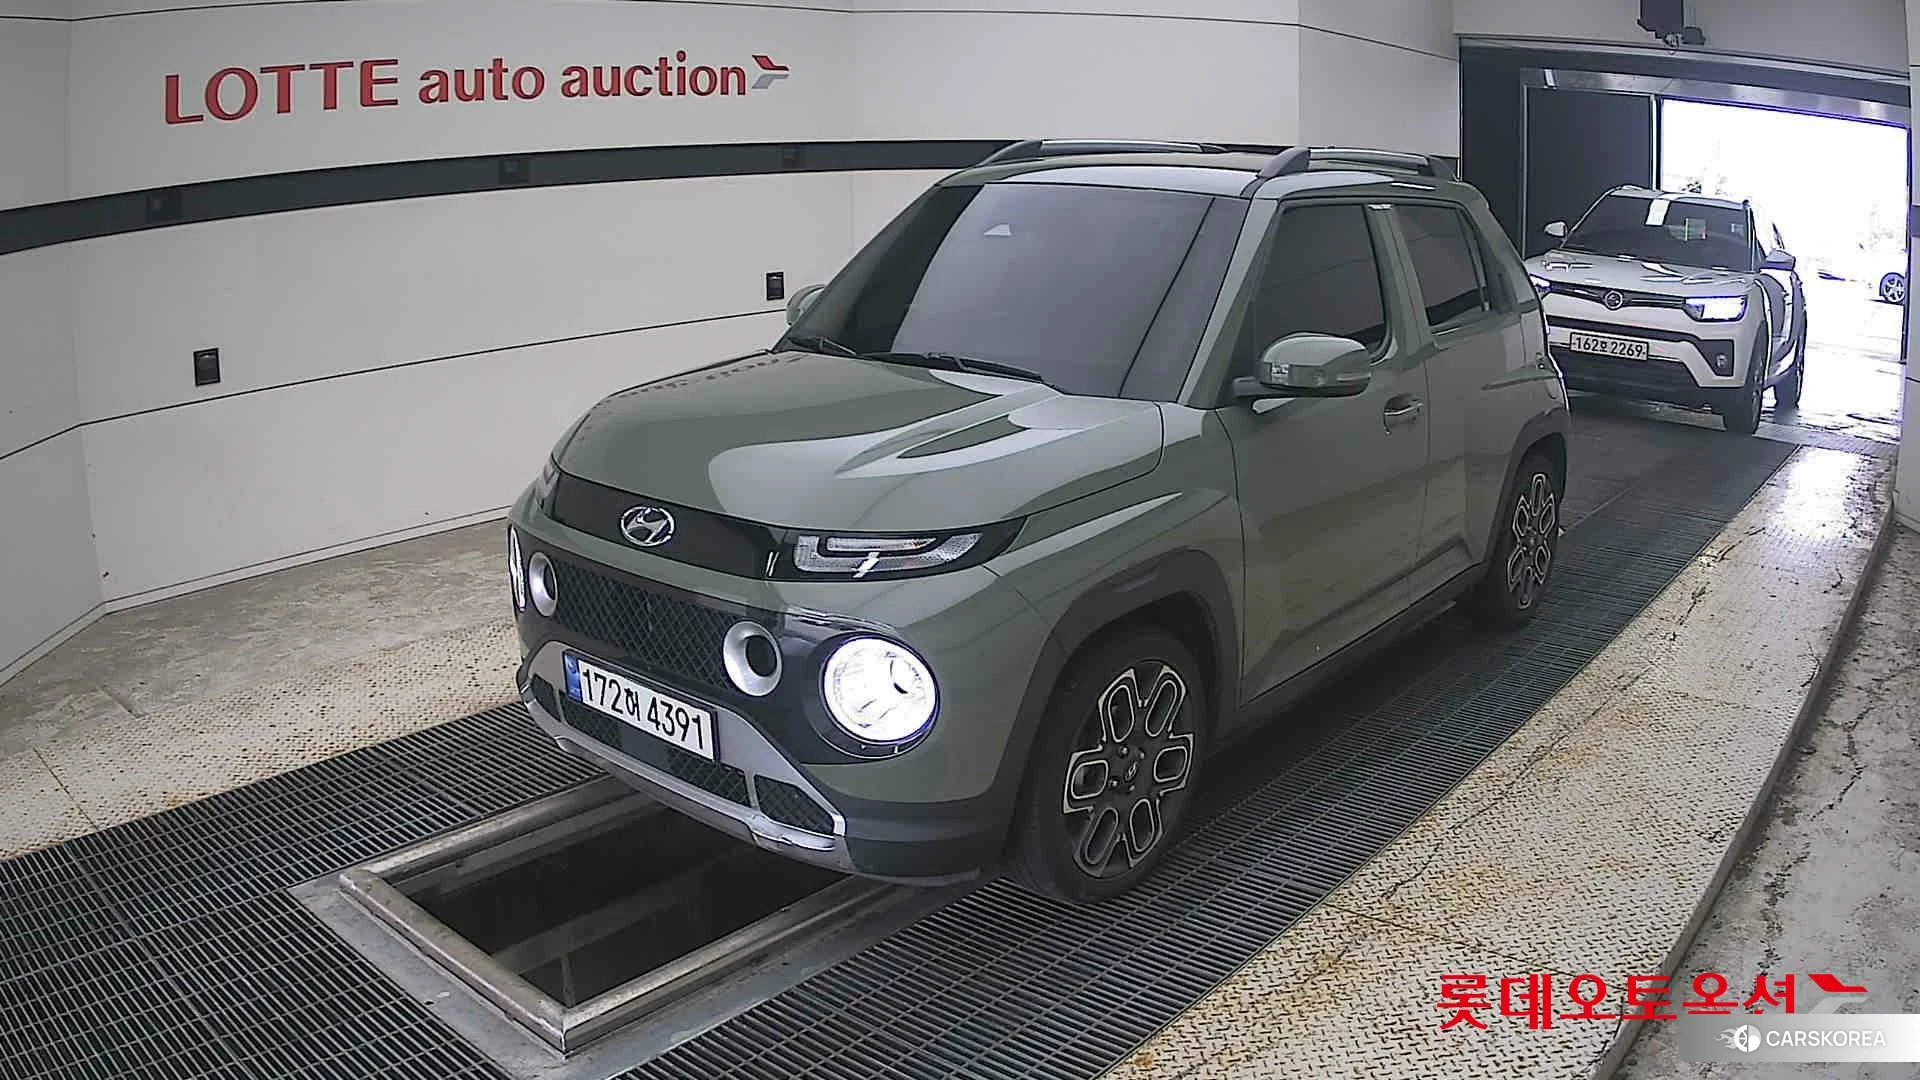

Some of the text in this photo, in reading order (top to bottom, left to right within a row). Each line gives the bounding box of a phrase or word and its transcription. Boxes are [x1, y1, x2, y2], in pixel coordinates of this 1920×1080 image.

[165, 51, 747, 124] LOTTE auto auction
[1610, 341, 1643, 358] 2269
[583, 669, 703, 749] 172허 4391
